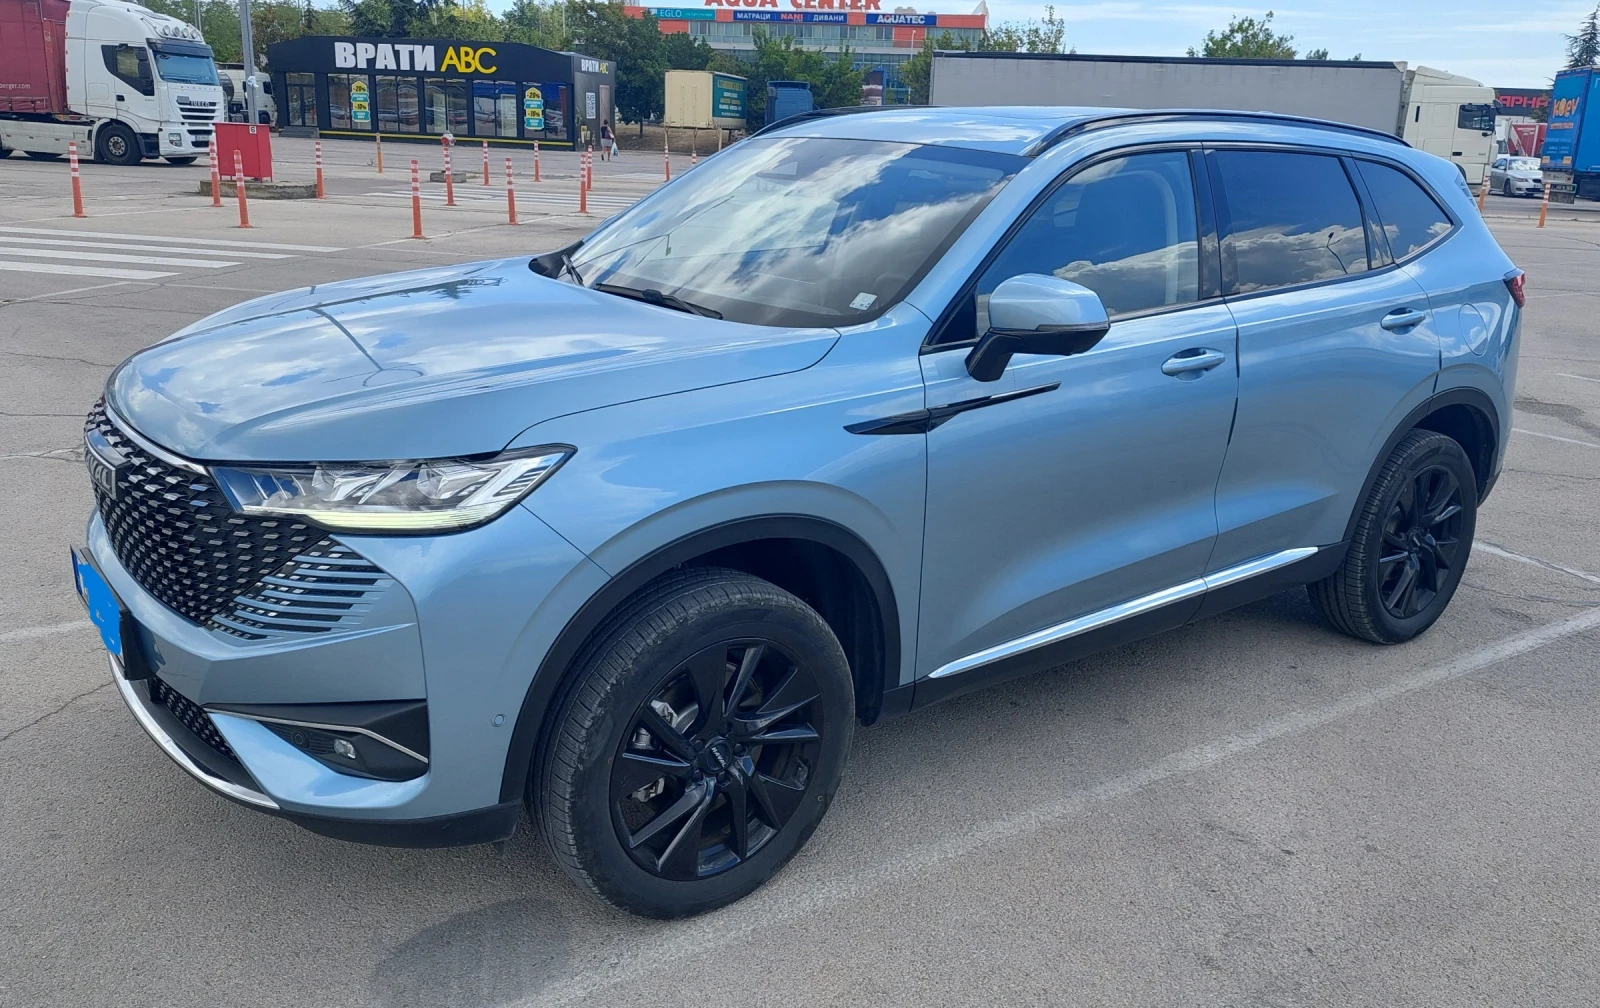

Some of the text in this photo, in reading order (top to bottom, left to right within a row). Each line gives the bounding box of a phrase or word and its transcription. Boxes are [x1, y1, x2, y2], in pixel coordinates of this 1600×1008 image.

[660, 9, 682, 18] EGLO
[736, 12, 771, 20] МАТРАЦИ
[812, 14, 844, 22] ДИВАНИ
[876, 14, 926, 24] AQUATEC
[334, 42, 497, 74] ВРАТИ ABC
[581, 59, 600, 73] ВРАТИ
